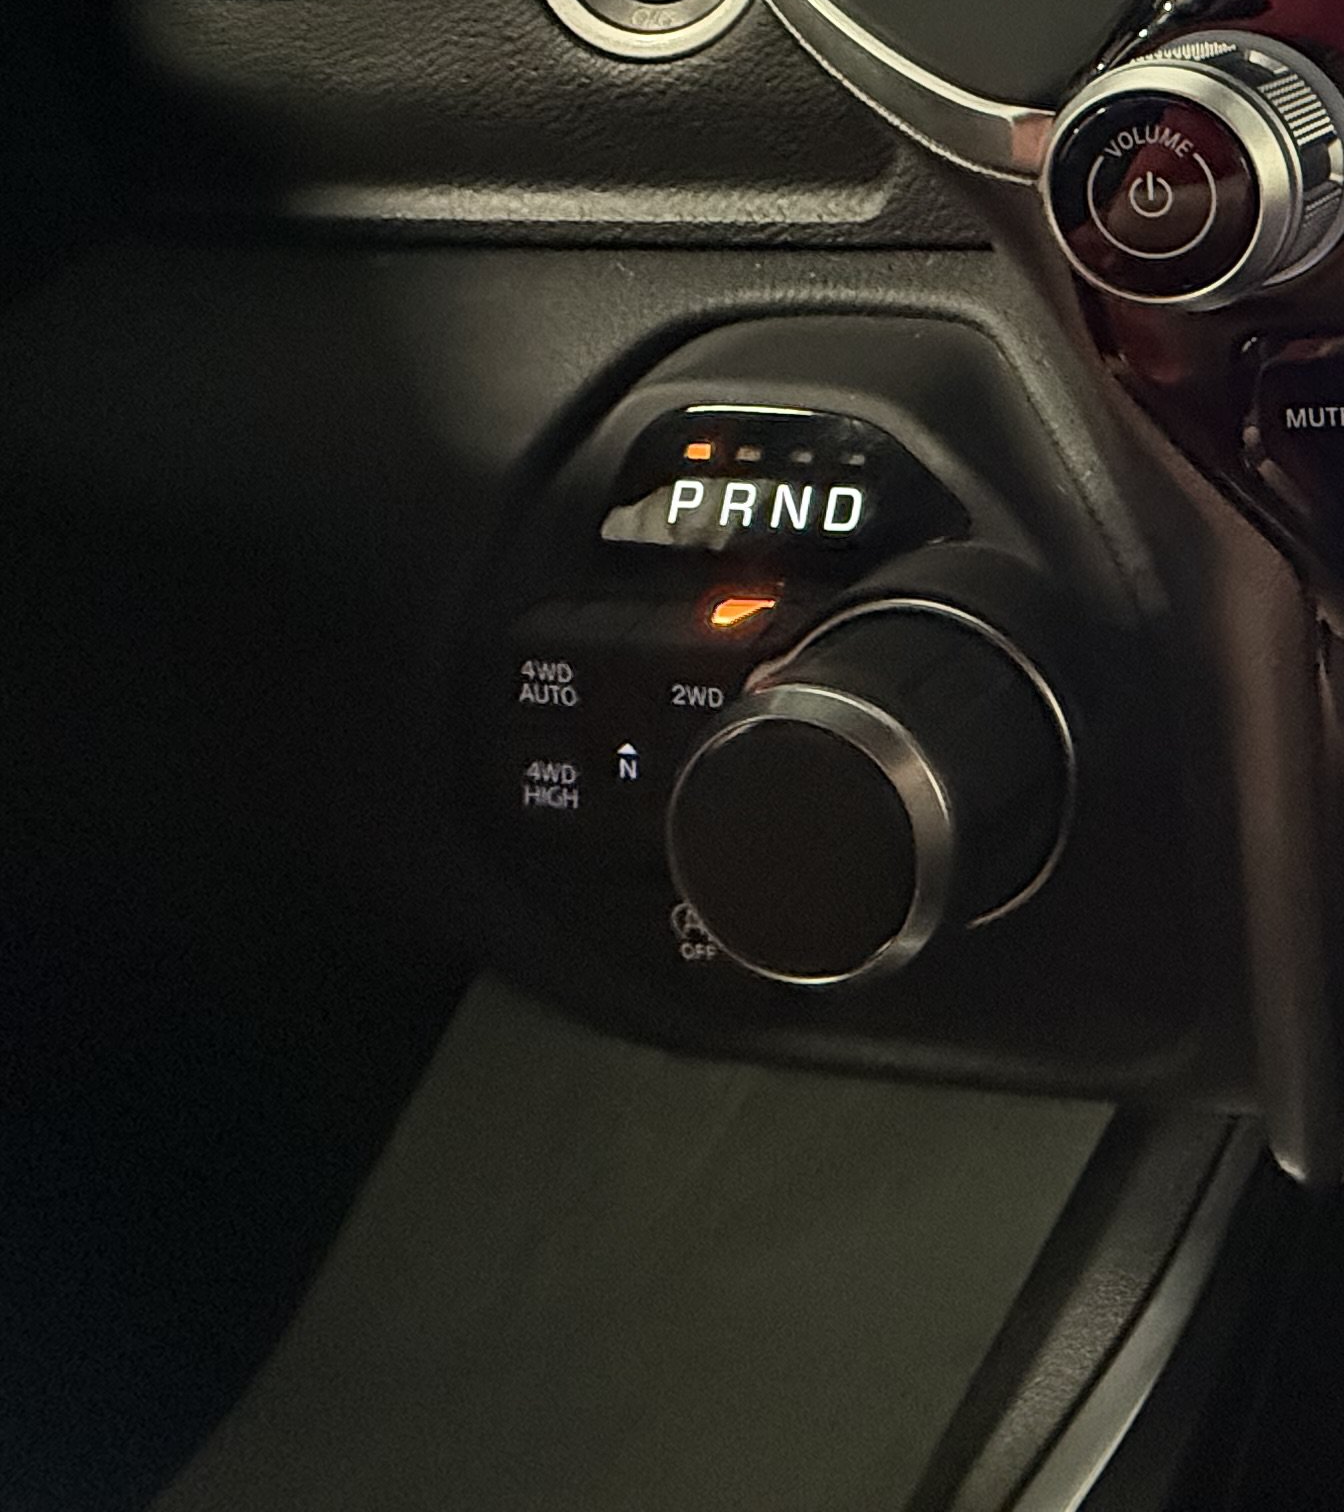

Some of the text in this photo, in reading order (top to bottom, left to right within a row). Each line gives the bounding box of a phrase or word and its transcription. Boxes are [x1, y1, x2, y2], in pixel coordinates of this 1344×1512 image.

[1104, 124, 1195, 160] VOLUME
[520, 659, 574, 683] 4WD
[519, 683, 579, 707] AUTO
[671, 684, 725, 708] 2WD
[526, 761, 577, 784] 4WD
[618, 758, 638, 780] N
[522, 785, 579, 809] HIGH
